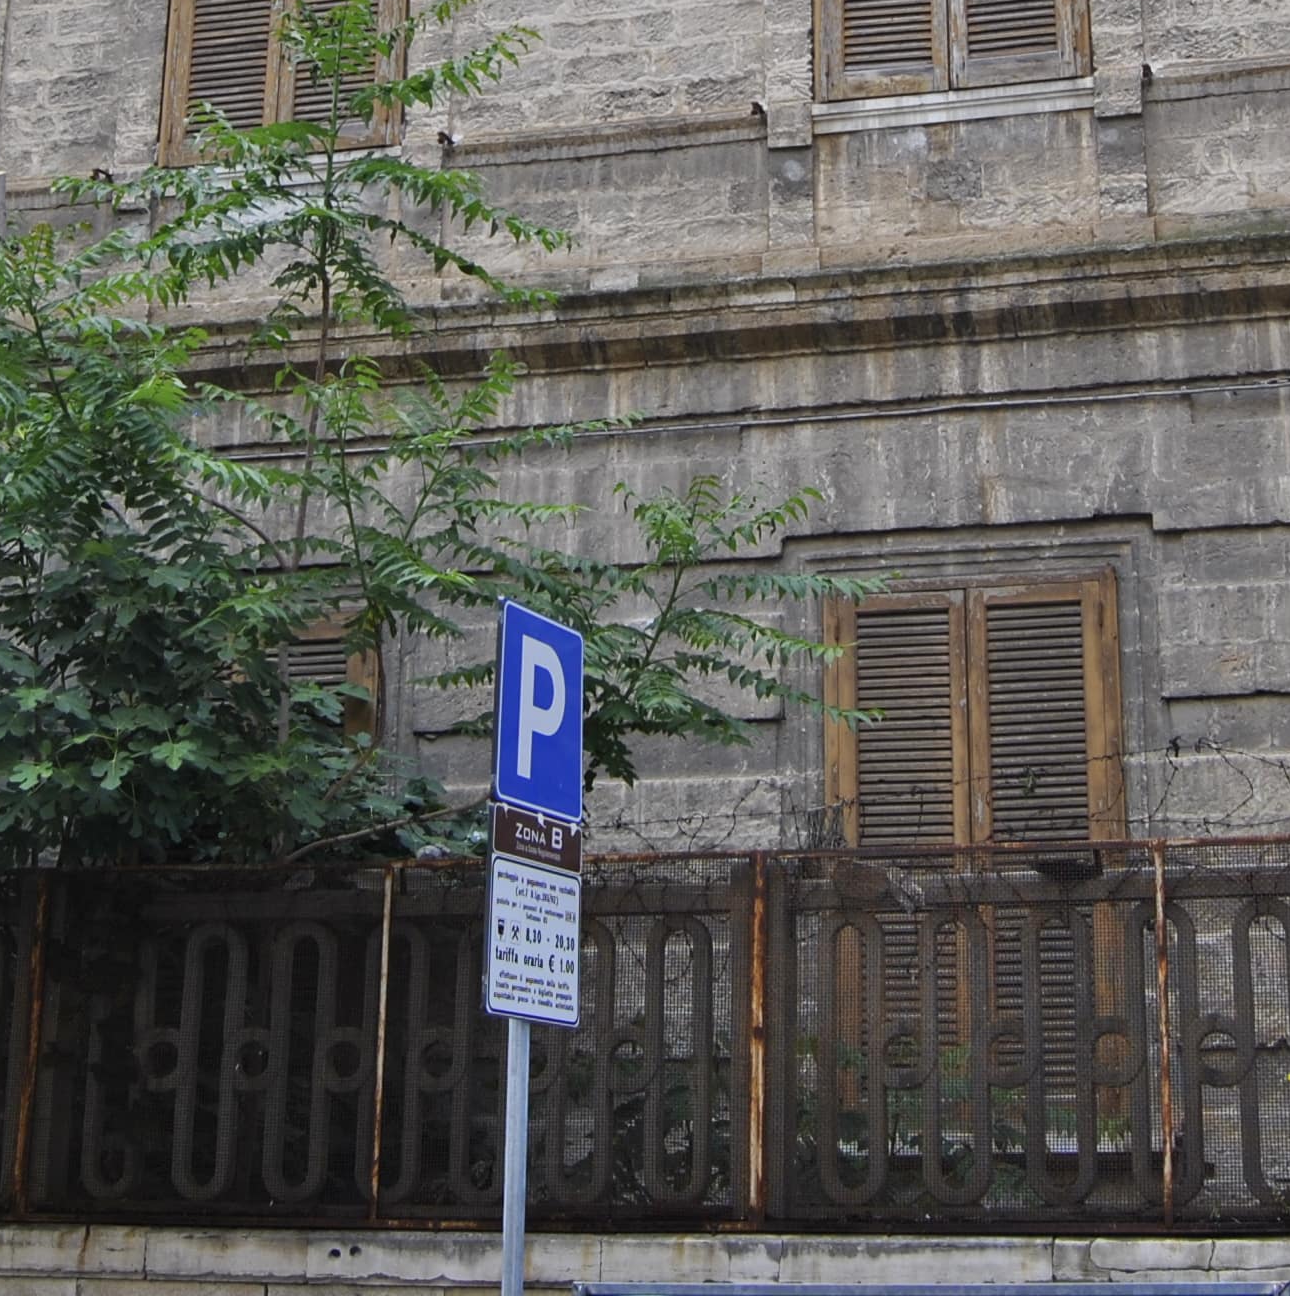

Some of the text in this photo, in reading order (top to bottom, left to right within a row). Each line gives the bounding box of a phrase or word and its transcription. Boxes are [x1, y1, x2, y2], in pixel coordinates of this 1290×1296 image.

[517, 634, 566, 780] P
[515, 823, 563, 849] ZONA B
[555, 934, 575, 951] 20,30
[495, 945, 518, 964] tariffa
[523, 953, 544, 969] oraria
[548, 954, 555, 973] €
